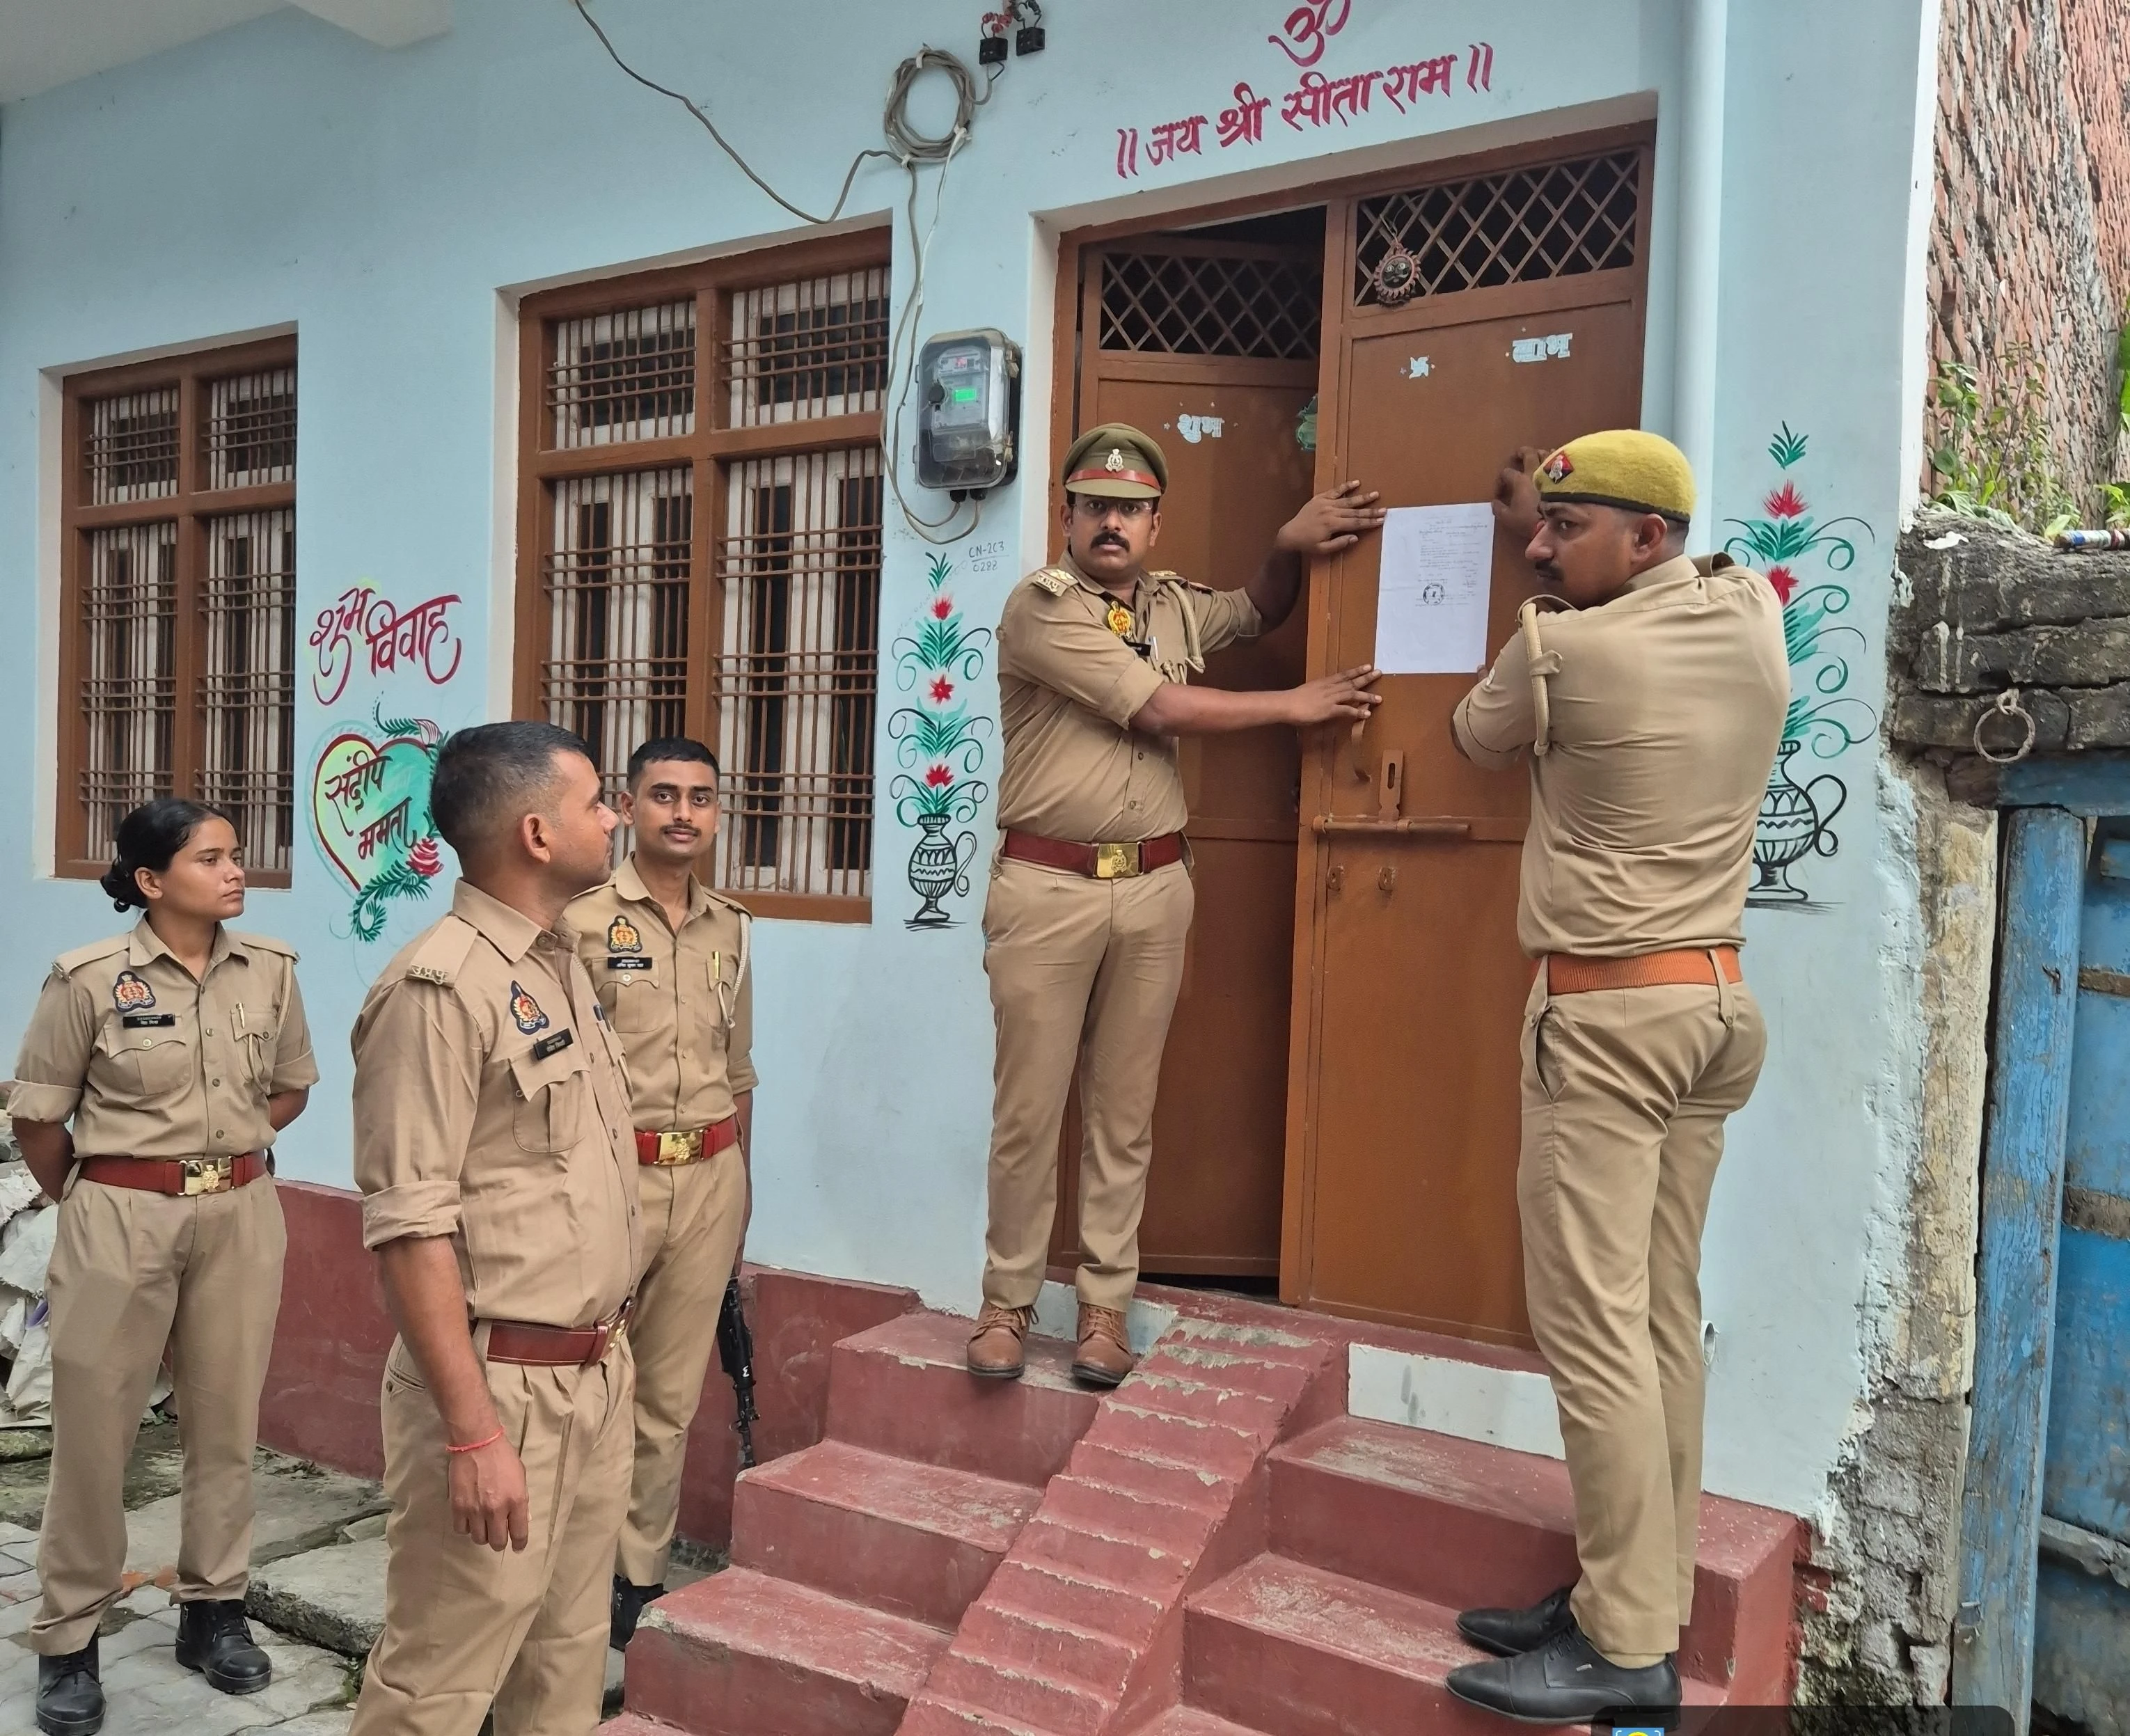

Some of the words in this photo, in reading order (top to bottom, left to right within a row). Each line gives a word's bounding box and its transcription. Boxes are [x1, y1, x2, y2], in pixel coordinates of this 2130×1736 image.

[1145, 114, 1209, 166] जय
[1215, 81, 1272, 148] श्री
[1281, 70, 1384, 133] सीता
[1382, 54, 1460, 115] राम
[1177, 413, 1225, 443] शुभ
[309, 587, 377, 706] शुभ
[365, 594, 463, 685] विवाह
[324, 750, 393, 837] संदीप
[358, 796, 418, 860] ममता
